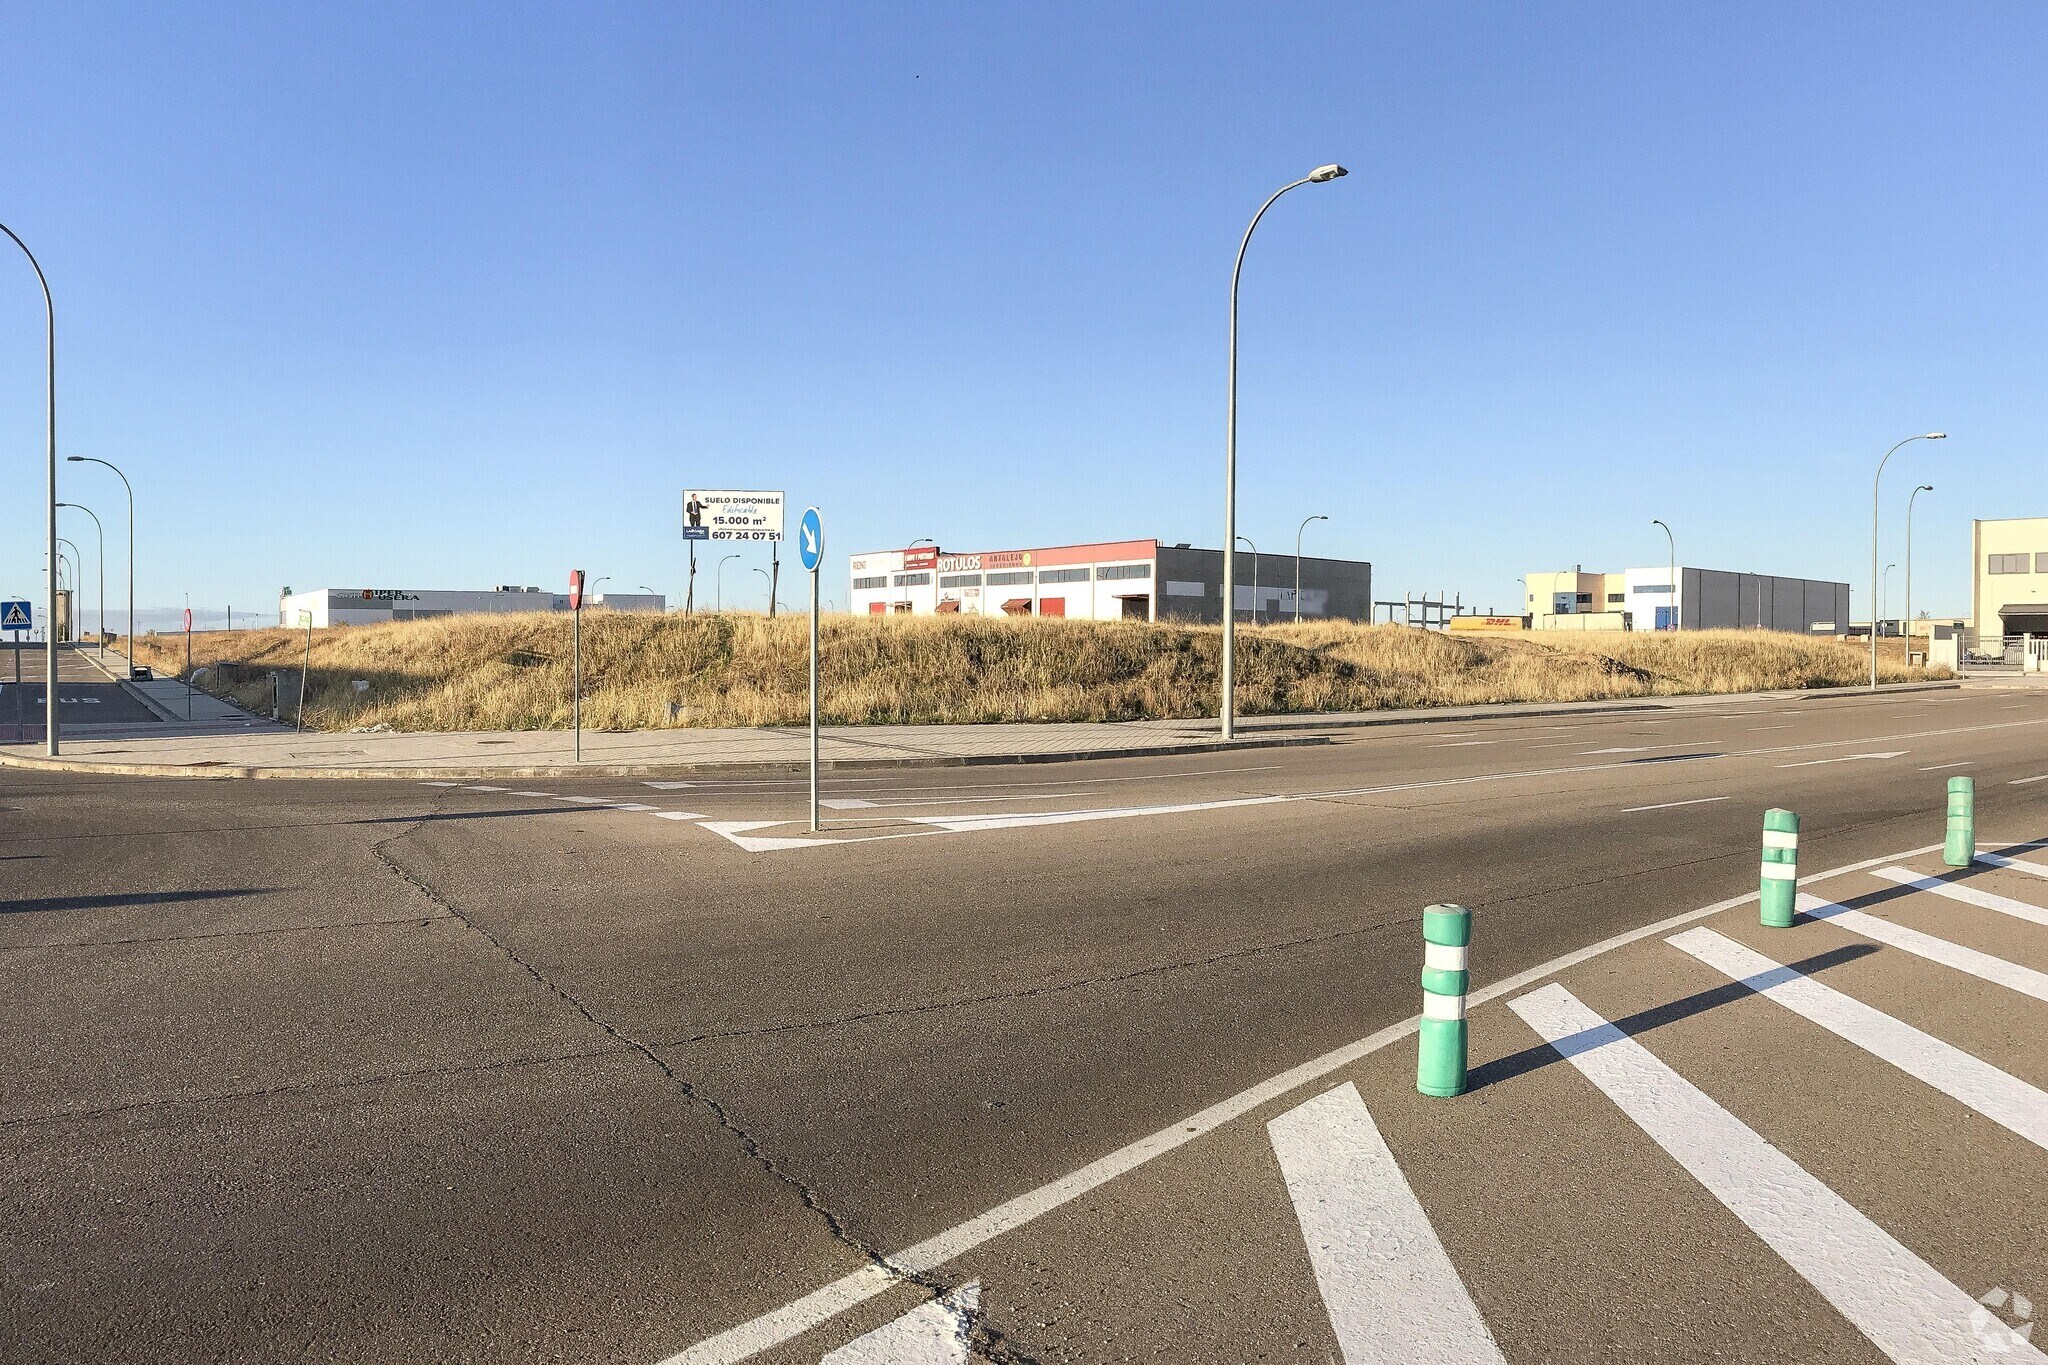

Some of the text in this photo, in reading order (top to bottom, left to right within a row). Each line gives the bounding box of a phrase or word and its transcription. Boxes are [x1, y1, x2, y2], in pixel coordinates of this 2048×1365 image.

[712, 516, 749, 525] 15.000
[712, 532, 733, 540] 607
[735, 532, 750, 540] 24
[752, 532, 766, 540] 07
[768, 532, 781, 540] 51
[1485, 618, 1512, 626] DHL
